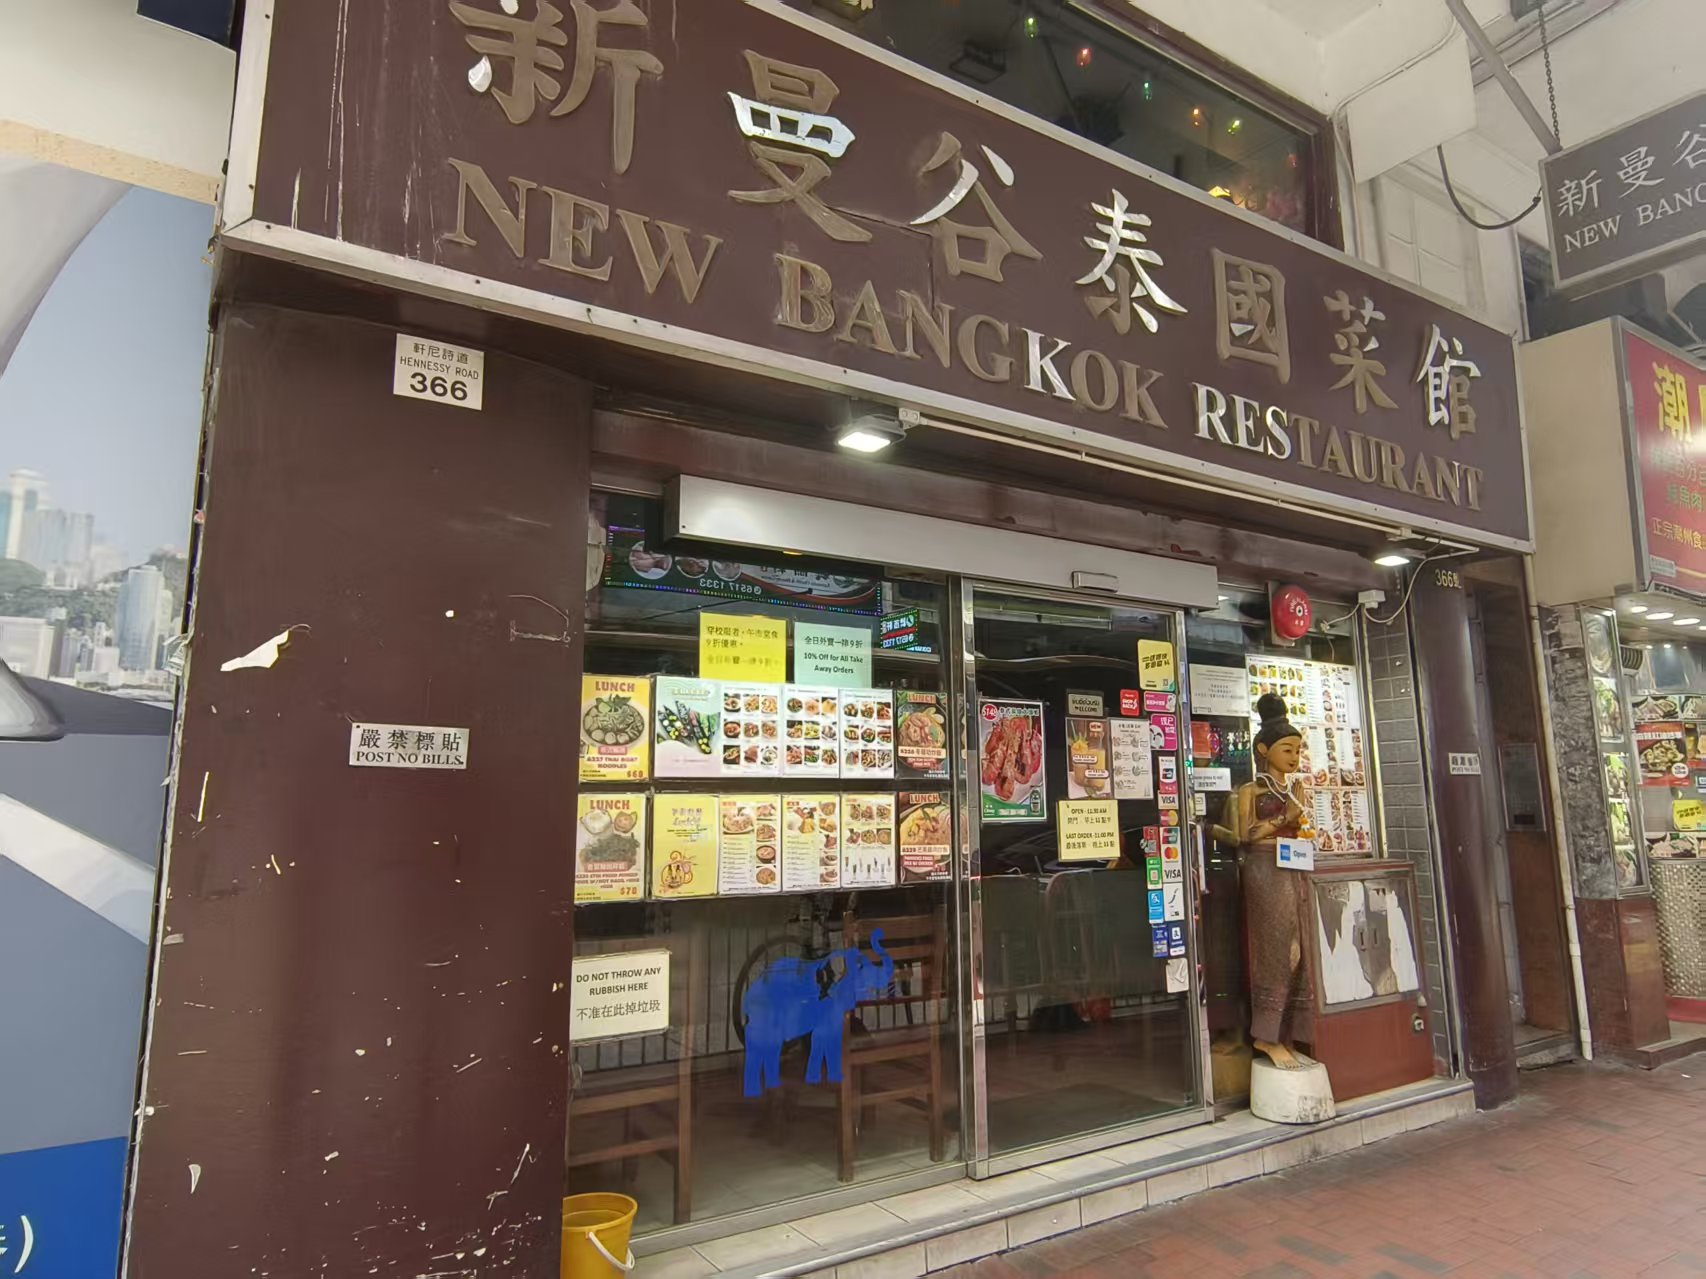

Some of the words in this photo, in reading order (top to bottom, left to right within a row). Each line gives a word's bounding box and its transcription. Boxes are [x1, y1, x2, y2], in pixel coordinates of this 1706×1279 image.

[449, 0, 1482, 440] 新曼谷泰國菜館
[1564, 215, 1621, 252] NEW
[442, 157, 724, 304] NEW
[774, 252, 1168, 429] BANGKOK
[1191, 381, 1485, 511] RESTAURANT
[413, 342, 469, 364] 軒尼詩道
[400, 355, 451, 375] HENNESSY
[455, 366, 479, 379] ROAD
[410, 372, 468, 401] 366
[804, 652, 817, 660] 10%
[849, 655, 863, 663] Take
[814, 664, 831, 673] Away
[833, 665, 854, 674] Orders
[595, 681, 635, 692] LUNCH
[907, 693, 936, 703] LUNCH
[359, 728, 462, 752] 嚴禁標貼
[356, 751, 394, 763] POST
[397, 752, 418, 764] NO
[422, 754, 463, 765] BILLS
[590, 799, 630, 810] LUNCH
[909, 794, 939, 803] LUNCH
[1164, 869, 1181, 880] VISA
[576, 974, 589, 983] DO
[591, 972, 609, 981] NOT
[611, 968, 643, 979] THROW
[644, 966, 661, 976] ANY
[589, 984, 625, 996] RUBBISH
[627, 982, 648, 992] HERE
[576, 999, 661, 1021] 不准在此掉垃圾
